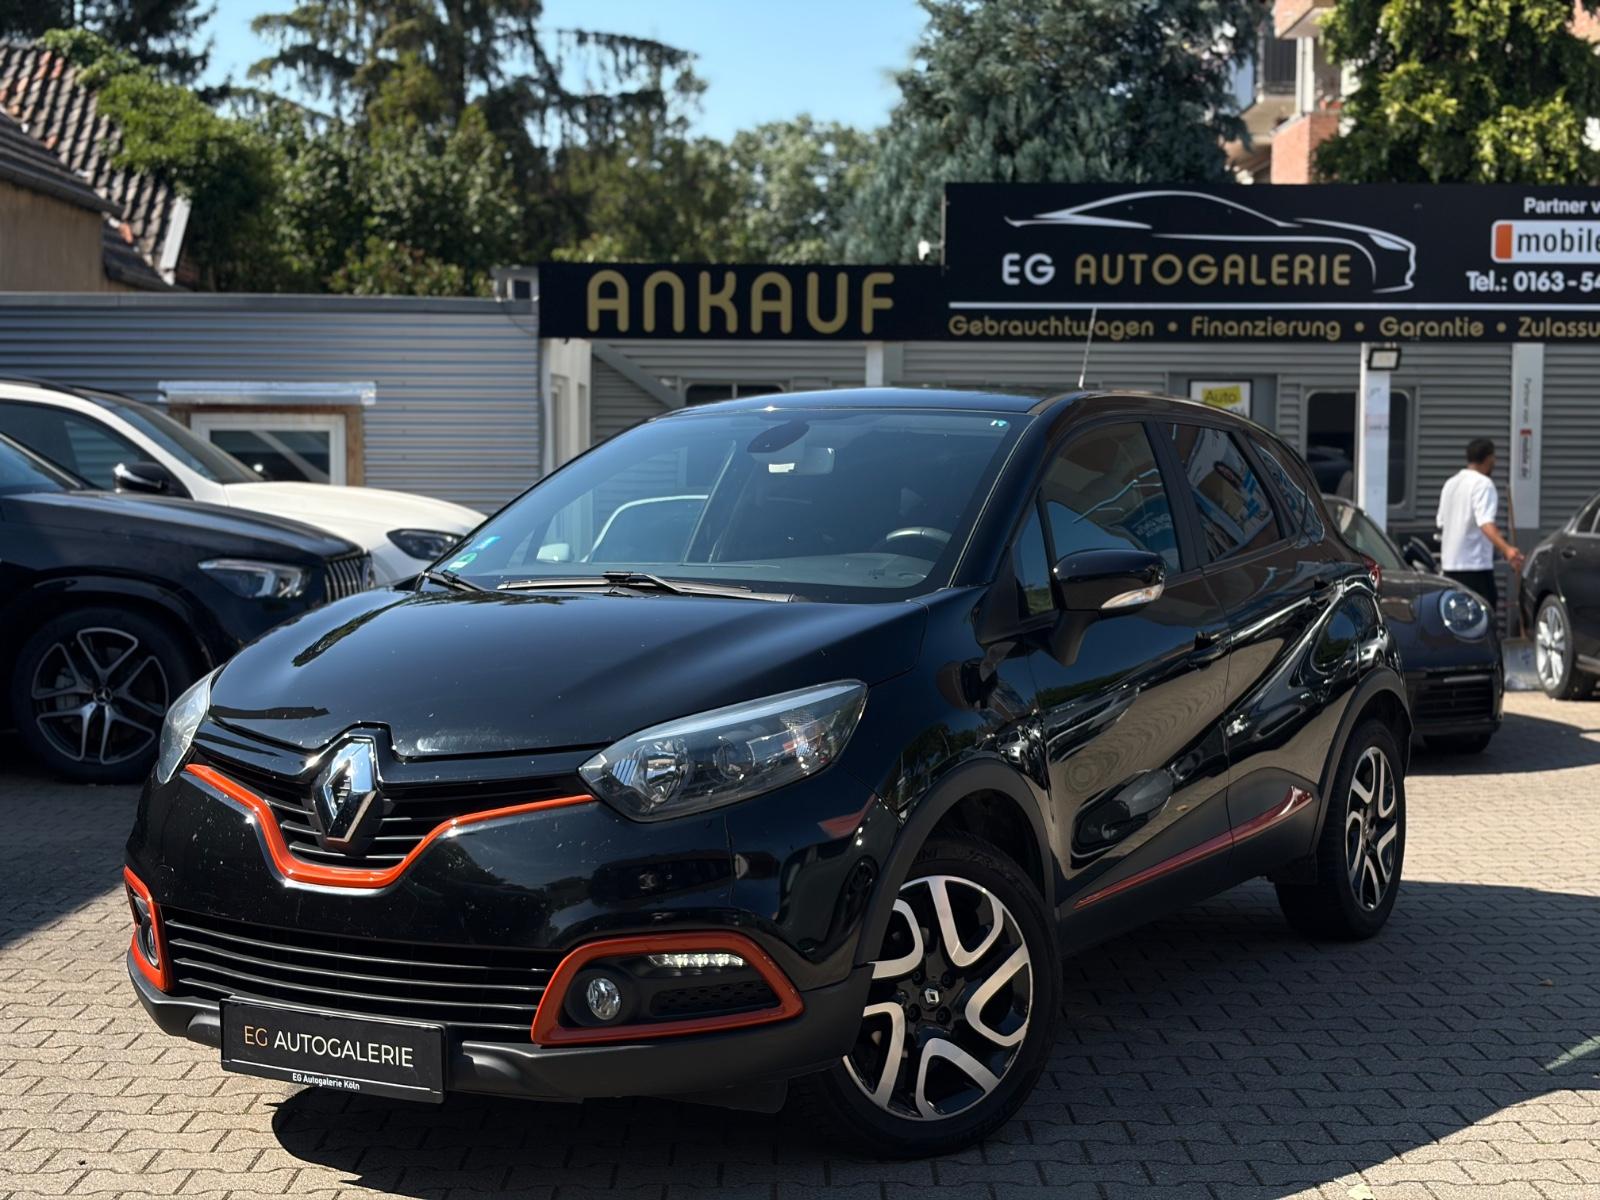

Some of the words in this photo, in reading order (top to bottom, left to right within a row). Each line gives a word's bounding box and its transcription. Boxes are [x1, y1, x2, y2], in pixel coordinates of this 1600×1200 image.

[1523, 197, 1588, 214] Partner
[1001, 252, 1056, 286] EG
[1074, 253, 1351, 286] AUTOGALERIE
[1465, 269, 1508, 292] Tel.:
[586, 269, 895, 335] ANKAUF
[948, 315, 1154, 341] Gebrauchtwagen
[1191, 316, 1341, 341] Finanzierung
[1379, 316, 1484, 337] Garantie
[244, 1025, 268, 1047] EG
[274, 1030, 414, 1068] AUTOGALERIE
[292, 1072, 302, 1082] EG
[303, 1074, 342, 1087] Autogalerie
[343, 1079, 360, 1091] Köln
